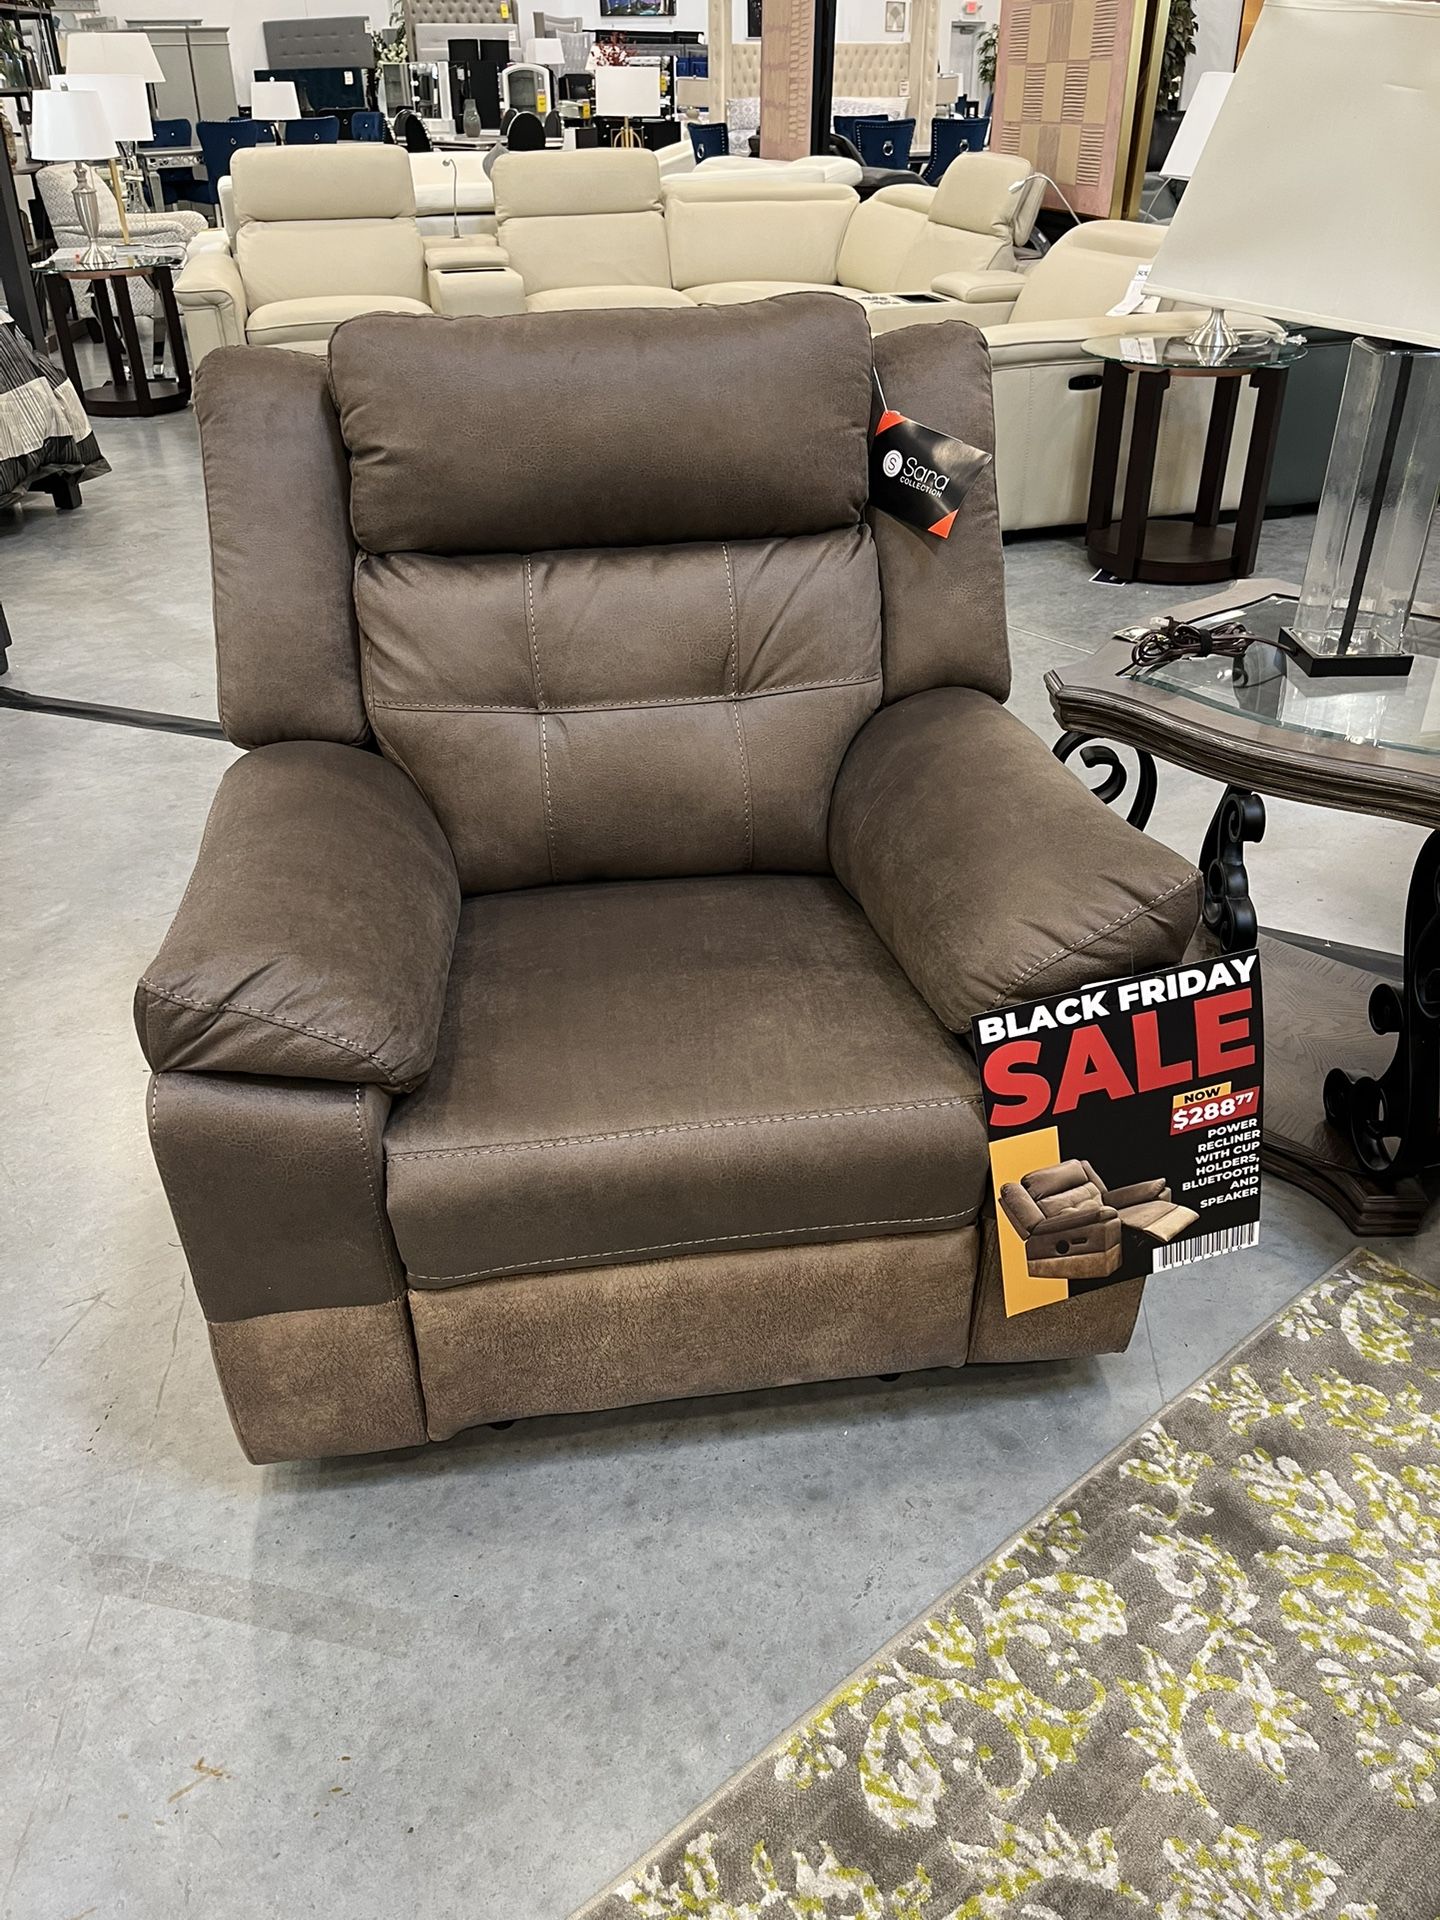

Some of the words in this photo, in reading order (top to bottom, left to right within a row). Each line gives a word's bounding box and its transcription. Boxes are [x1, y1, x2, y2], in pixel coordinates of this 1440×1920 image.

[903, 457, 950, 490] Sara
[899, 475, 943, 498] COLLECTION
[978, 989, 1110, 1045] BLACK
[1117, 954, 1257, 1012] FRIDAY
[983, 987, 1256, 1127] SALE
[1183, 1086, 1221, 1104] NOW
[1207, 1118, 1258, 1138] POWER
[1197, 1129, 1261, 1153] RECLINER
[1195, 1148, 1230, 1165] WITH
[1232, 1141, 1261, 1155] CUP
[1195, 1153, 1260, 1176] HOLDERS,
[1181, 1164, 1260, 1191] BLUETOOTH
[1229, 1176, 1259, 1190] AND
[1199, 1187, 1259, 1209] SPEAKER
